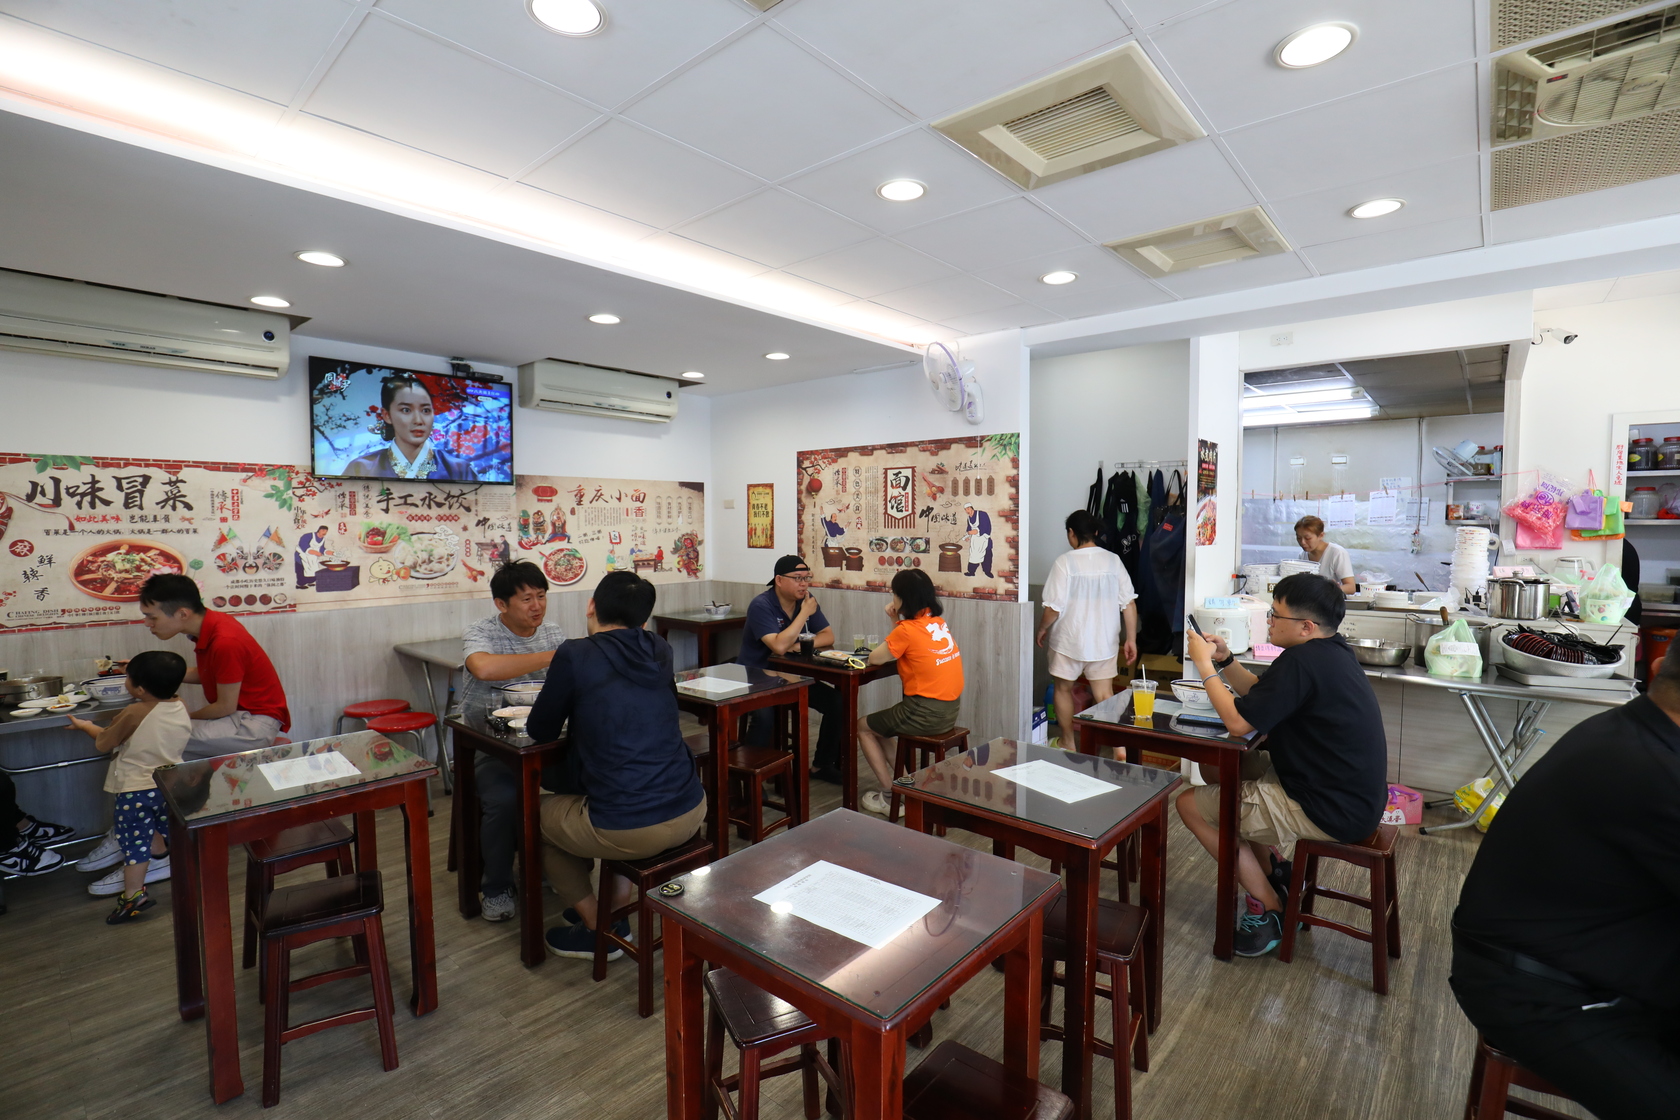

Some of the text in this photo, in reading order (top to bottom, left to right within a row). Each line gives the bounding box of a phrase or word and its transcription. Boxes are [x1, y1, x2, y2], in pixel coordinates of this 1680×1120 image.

[25, 474, 194, 512] 川味冒菜
[376, 487, 472, 514] 手工水饺
[567, 484, 647, 506] 重庆小面
[888, 470, 911, 513] 面馆
[74, 514, 122, 524] 如此美味
[633, 506, 645, 517] 香
[34, 587, 50, 601] 香
